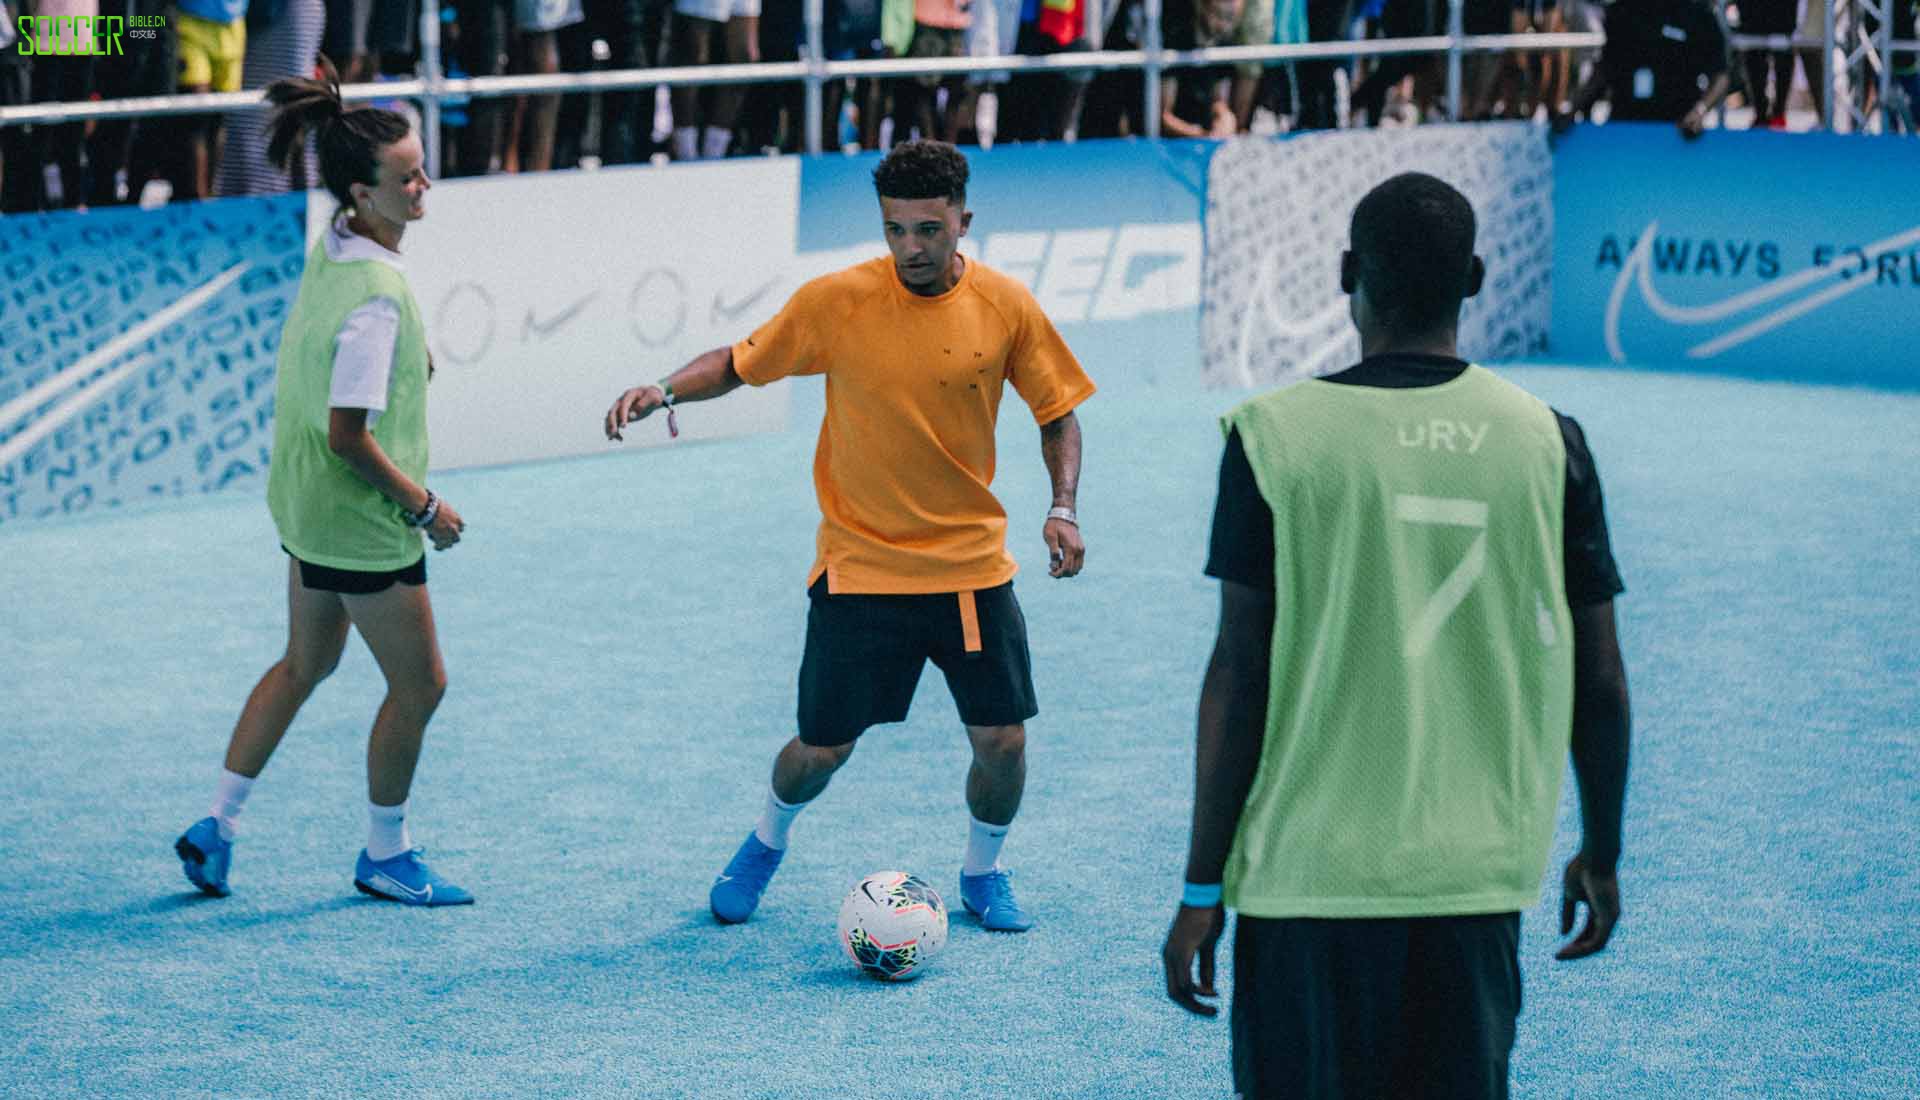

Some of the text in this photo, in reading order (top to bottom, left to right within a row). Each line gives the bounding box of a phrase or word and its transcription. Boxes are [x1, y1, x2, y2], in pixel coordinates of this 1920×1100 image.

[1595, 233, 1920, 287] AWAYS FOR
[1396, 494, 1489, 658] 7
